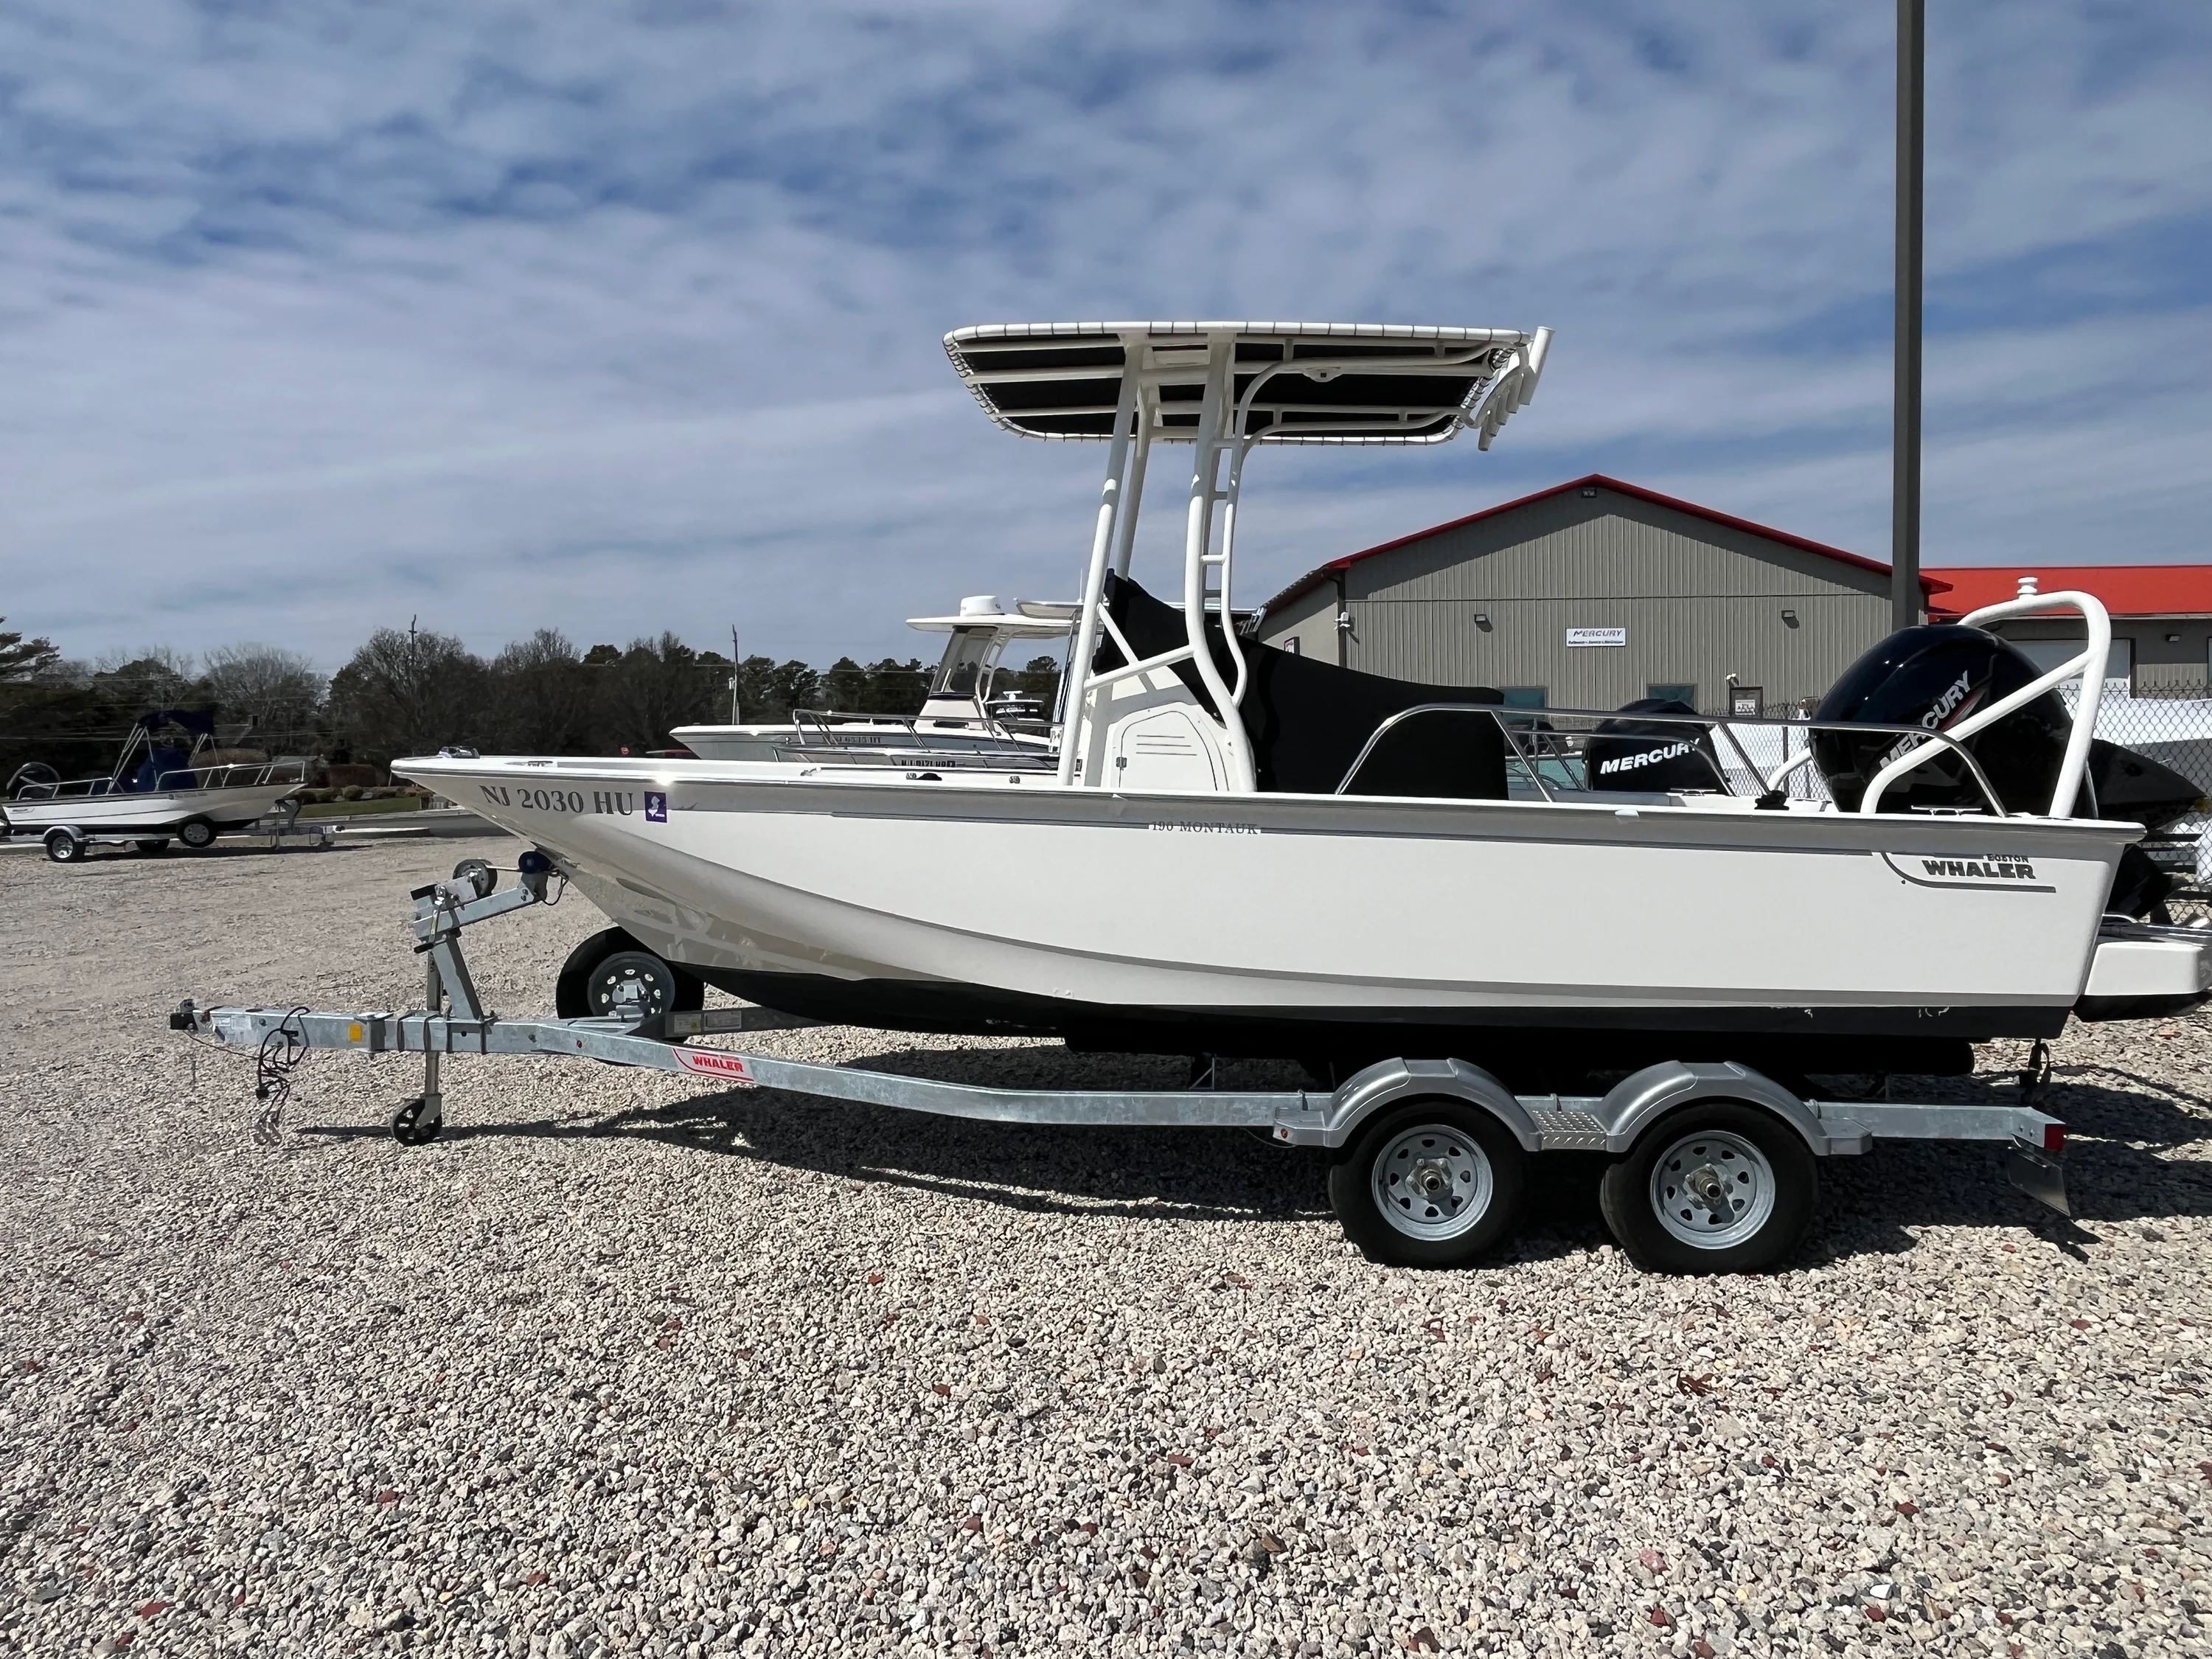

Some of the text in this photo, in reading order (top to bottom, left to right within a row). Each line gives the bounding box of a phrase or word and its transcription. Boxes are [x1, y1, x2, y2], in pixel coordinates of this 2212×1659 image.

[1600, 737, 1700, 774] MERCURY
[479, 785, 633, 815] NJ 2030 HU
[1152, 821, 1259, 835] 190 MONTAUK
[1986, 853, 2029, 863] BOSTON
[1921, 860, 2037, 880] WHALER
[692, 1055, 744, 1073] WHALER
